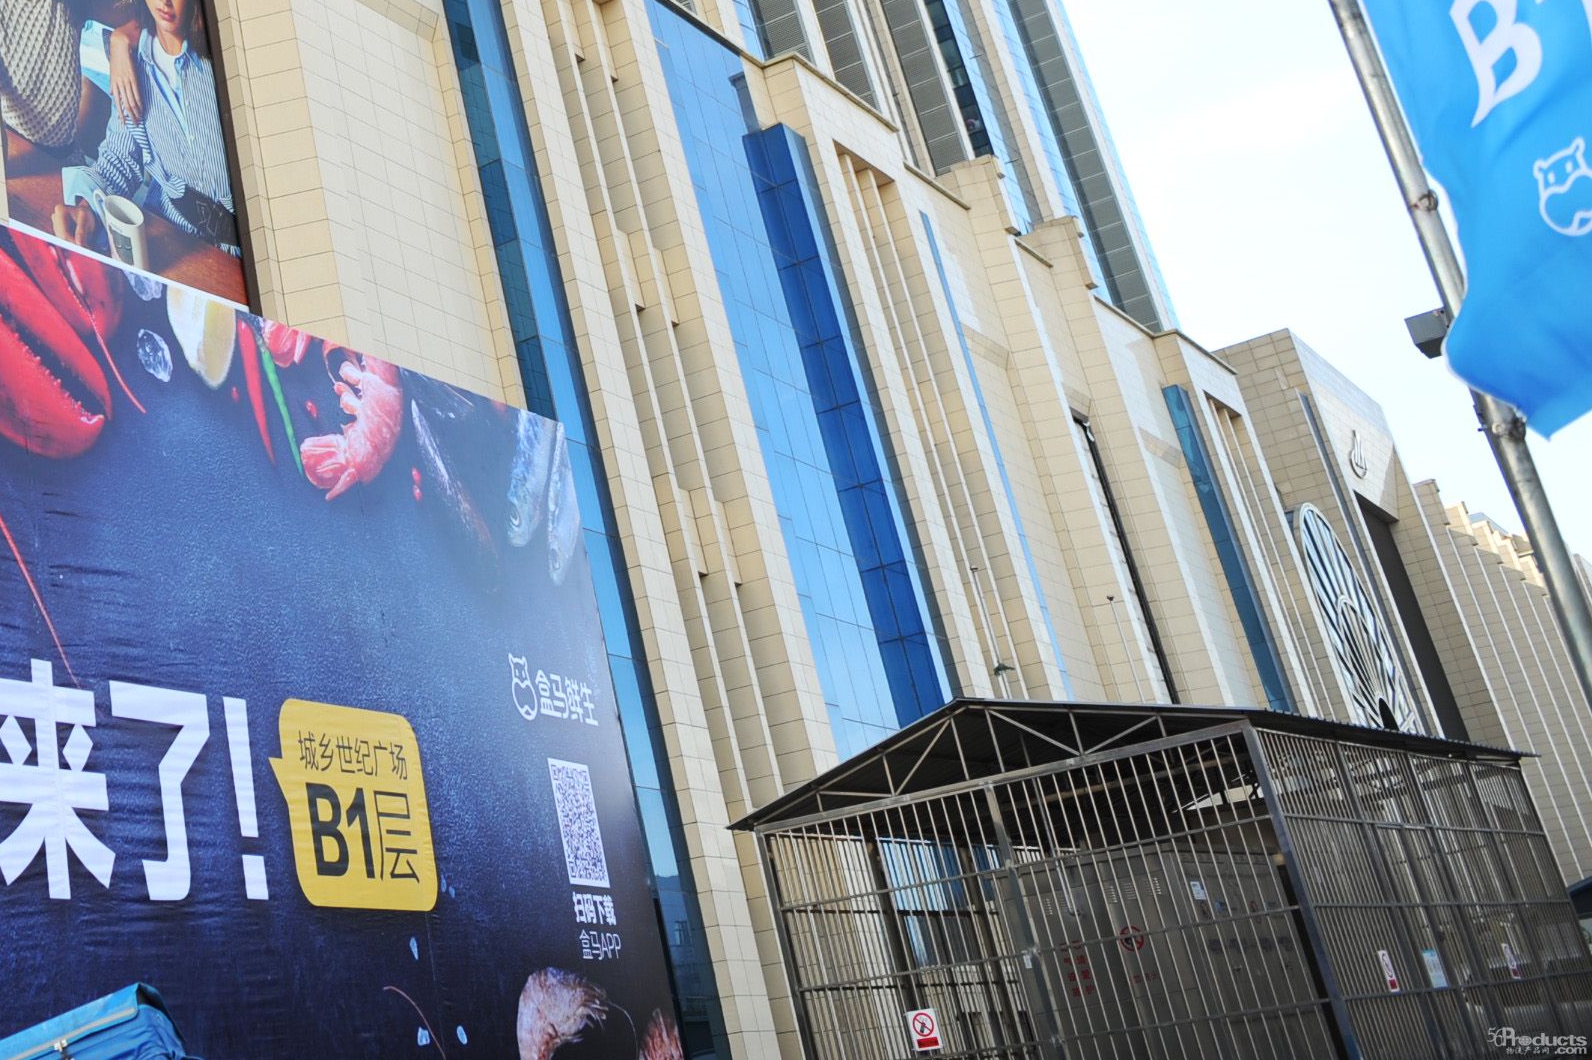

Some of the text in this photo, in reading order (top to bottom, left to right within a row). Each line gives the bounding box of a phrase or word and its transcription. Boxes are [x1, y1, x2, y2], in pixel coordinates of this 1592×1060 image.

[535, 669, 599, 727] 盒马鲜生
[298, 730, 408, 780] 城乡世纪广场
[305, 782, 420, 884] B1层
[572, 891, 616, 926] 扫码下载
[579, 929, 621, 960] 盒马APP
